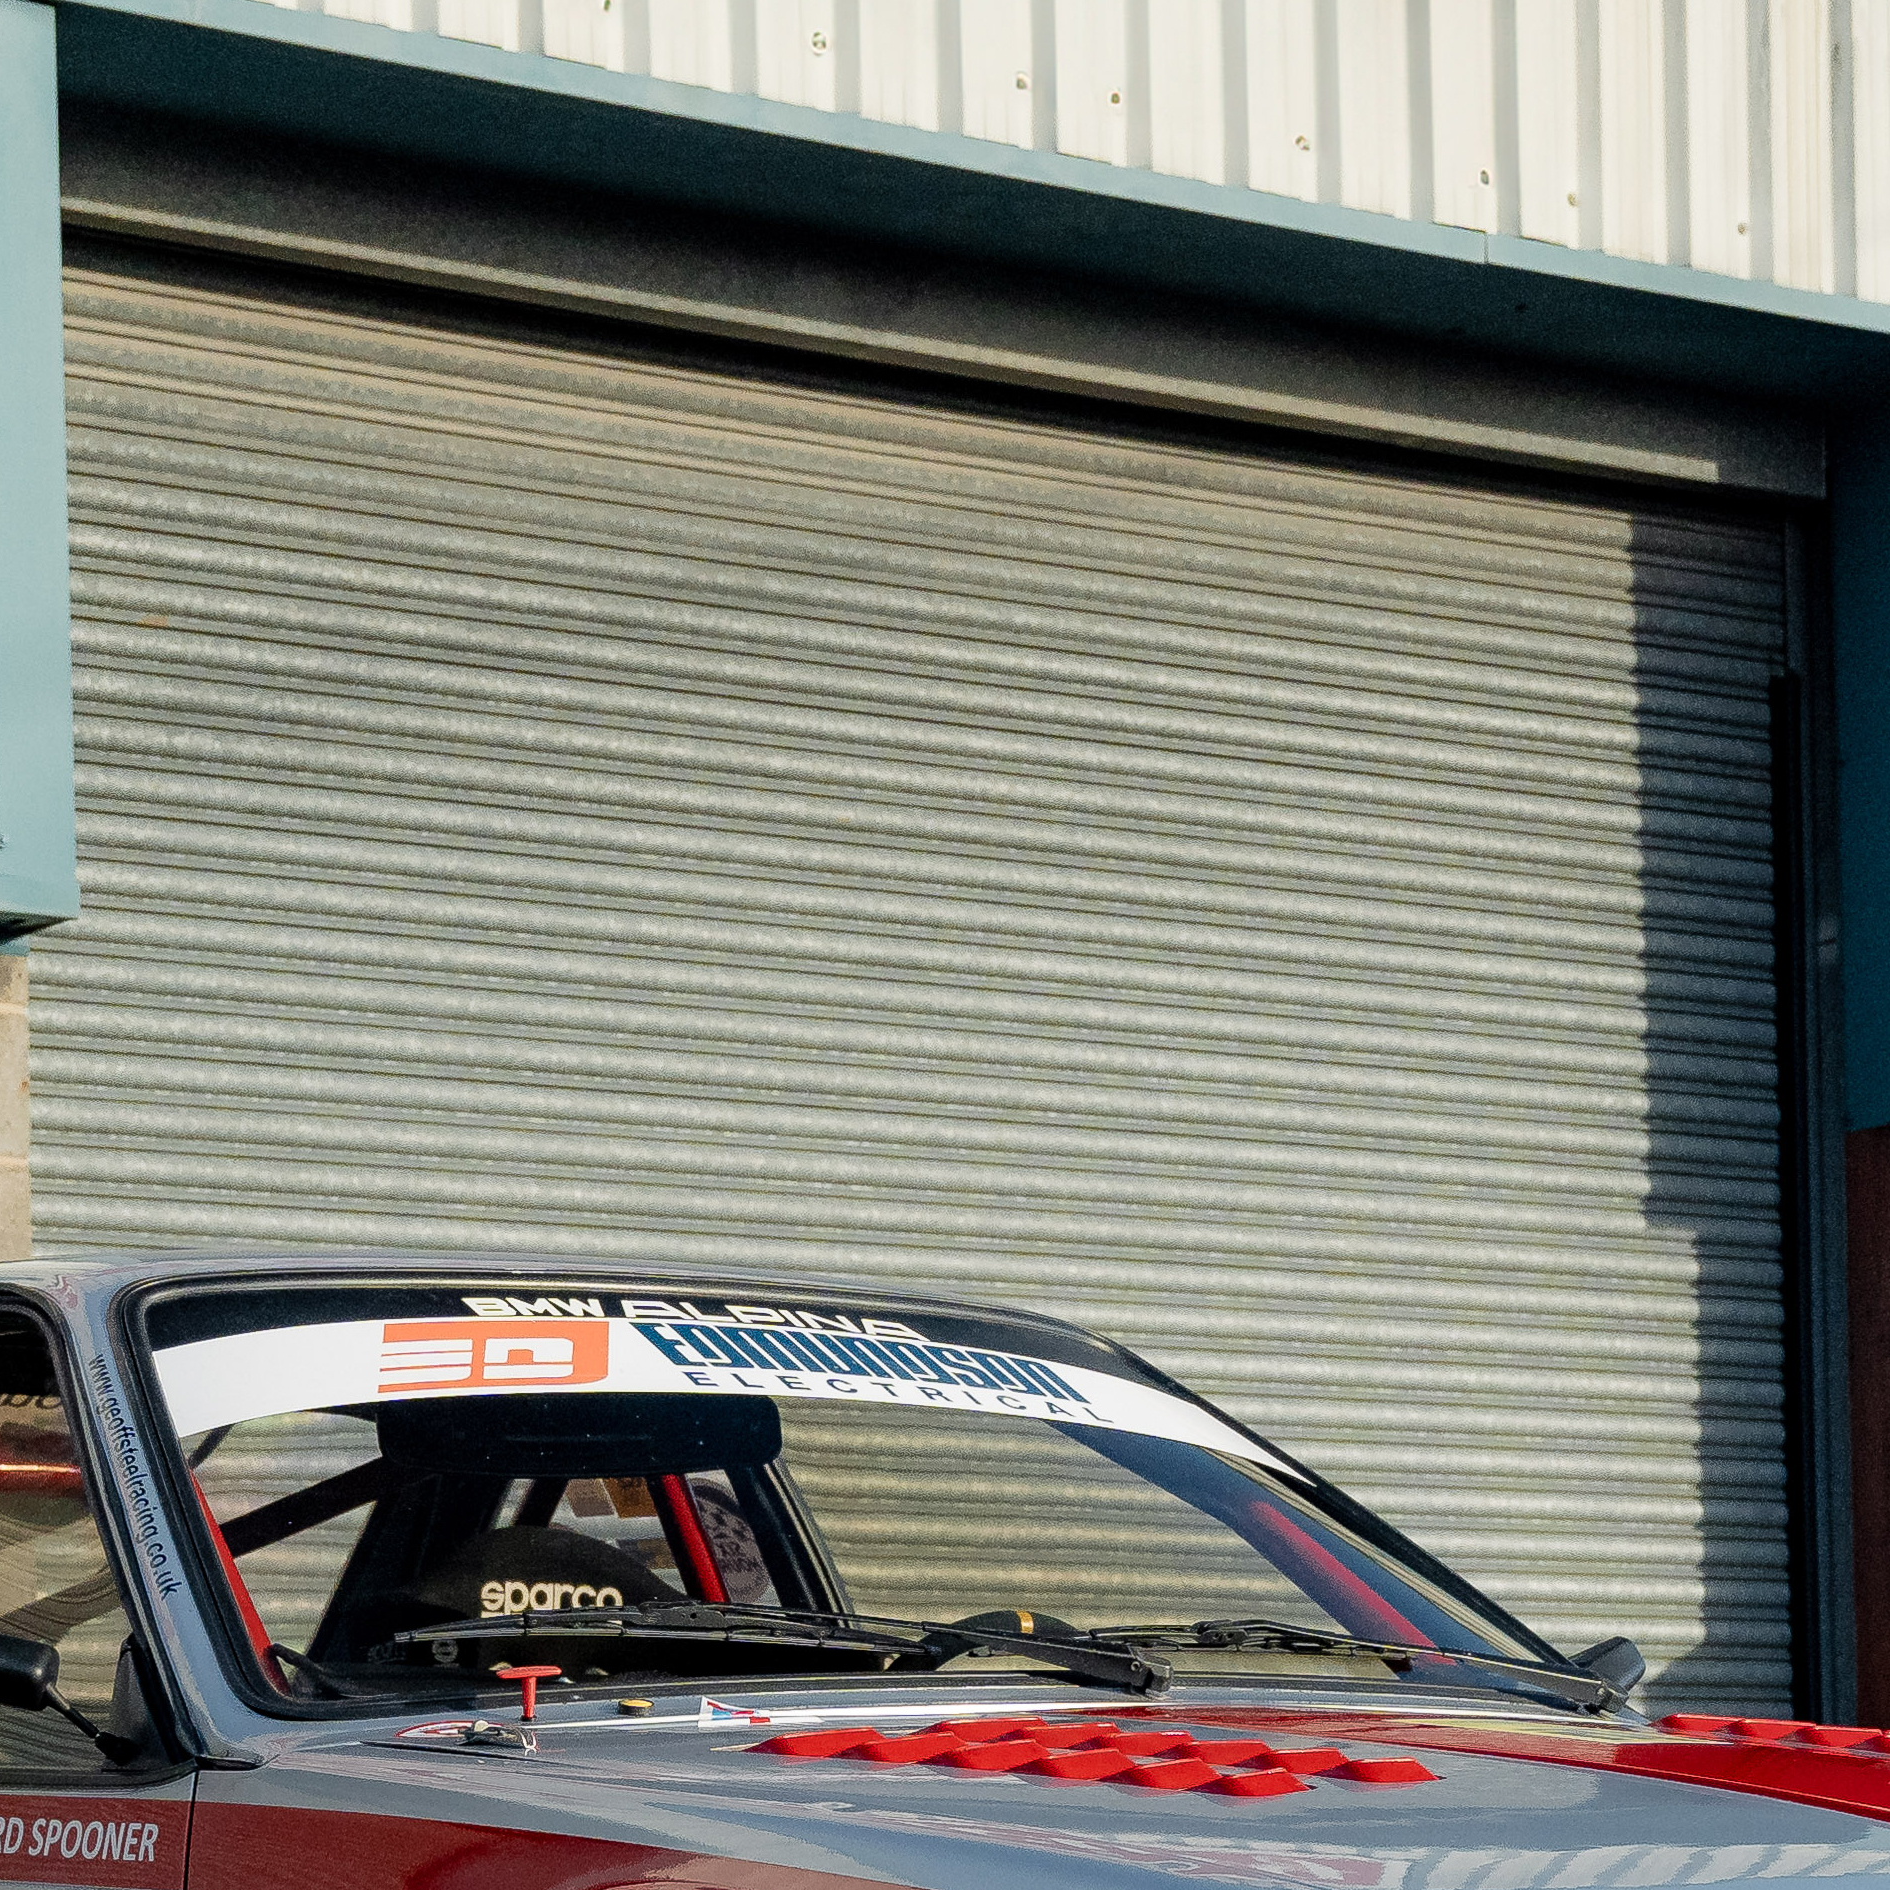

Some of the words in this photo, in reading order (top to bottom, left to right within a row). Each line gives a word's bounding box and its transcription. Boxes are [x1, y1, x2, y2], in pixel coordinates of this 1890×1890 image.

[461, 1297, 605, 1317] BMW
[620, 1300, 932, 1341] ALPINA
[628, 1322, 1092, 1404] EDMUNDSON
[682, 1370, 1115, 1424] ELECTRICAL
[89, 1354, 183, 1602] www.geoffsteelracing.co.uk
[480, 1580, 624, 1614] sparco
[28, 1817, 159, 1862] SPOONER
